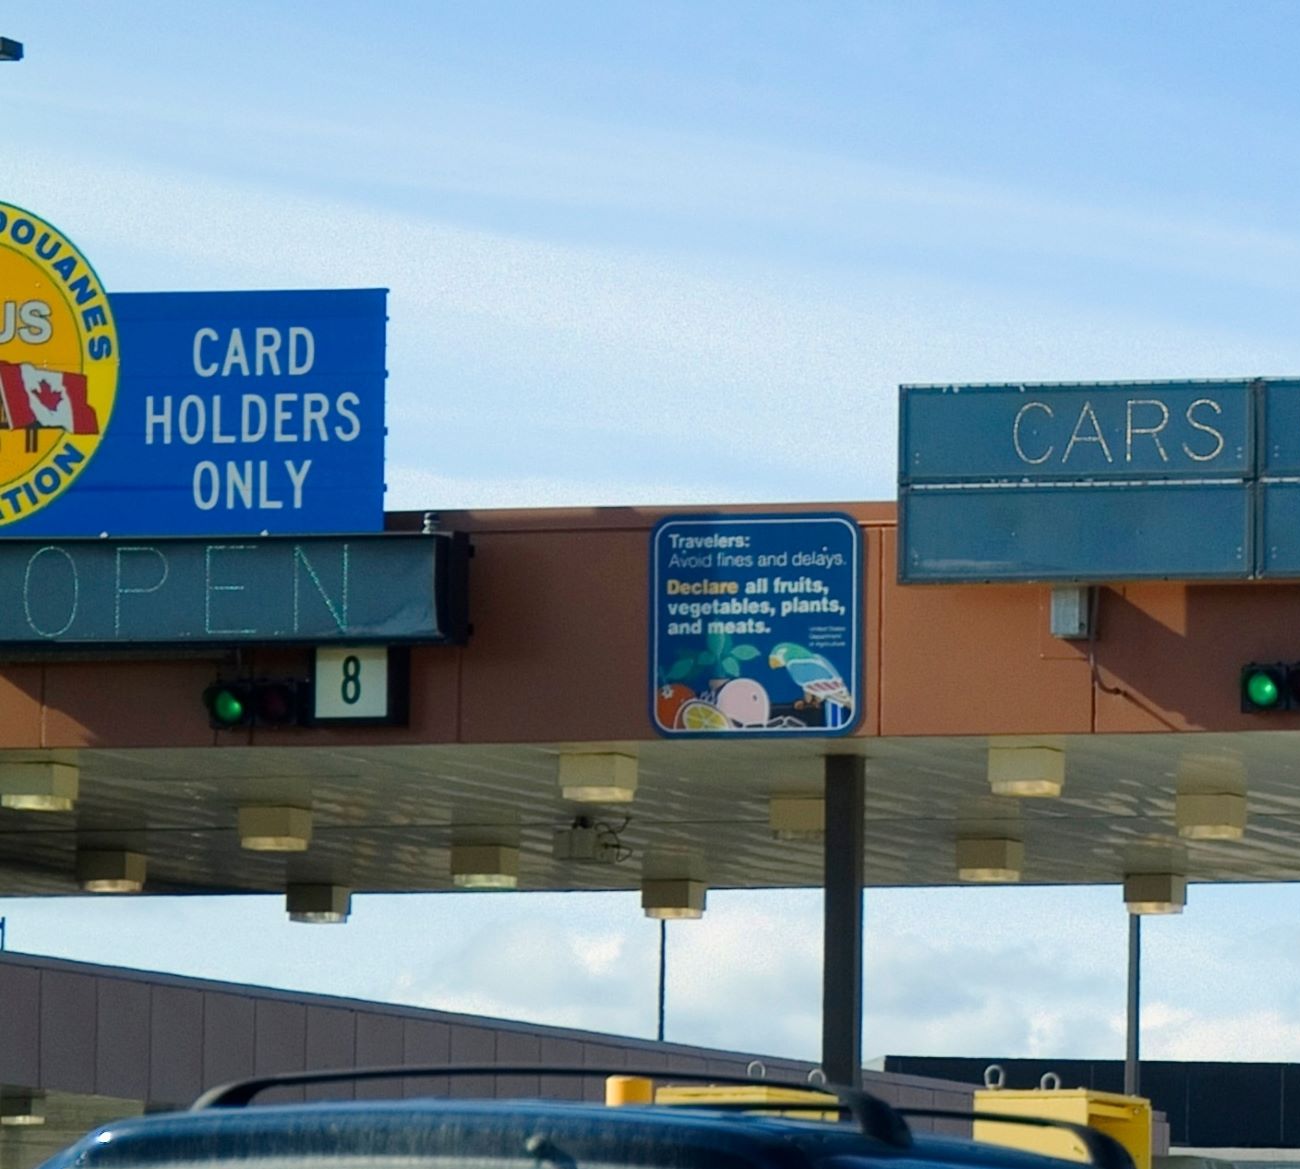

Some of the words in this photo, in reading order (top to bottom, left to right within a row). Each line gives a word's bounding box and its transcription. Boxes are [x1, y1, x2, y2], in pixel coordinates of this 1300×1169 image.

[192, 326, 316, 378] CARD
[144, 391, 362, 446] HOLDERS
[1012, 399, 1225, 465] CARS
[192, 459, 312, 511] ONLY
[668, 534, 750, 549] Travelers:
[668, 552, 713, 569] Avoid
[716, 551, 754, 568] fines
[757, 551, 788, 568] and
[792, 551, 847, 570] delays.
[23, 544, 350, 638] OPEN
[666, 578, 739, 596] Declare
[744, 578, 768, 594] all
[773, 576, 829, 595] fruits,
[667, 598, 776, 618] vegetables,
[780, 597, 846, 617] plants,
[667, 619, 702, 636] and
[707, 618, 771, 635] meats.
[341, 655, 362, 705] 8
